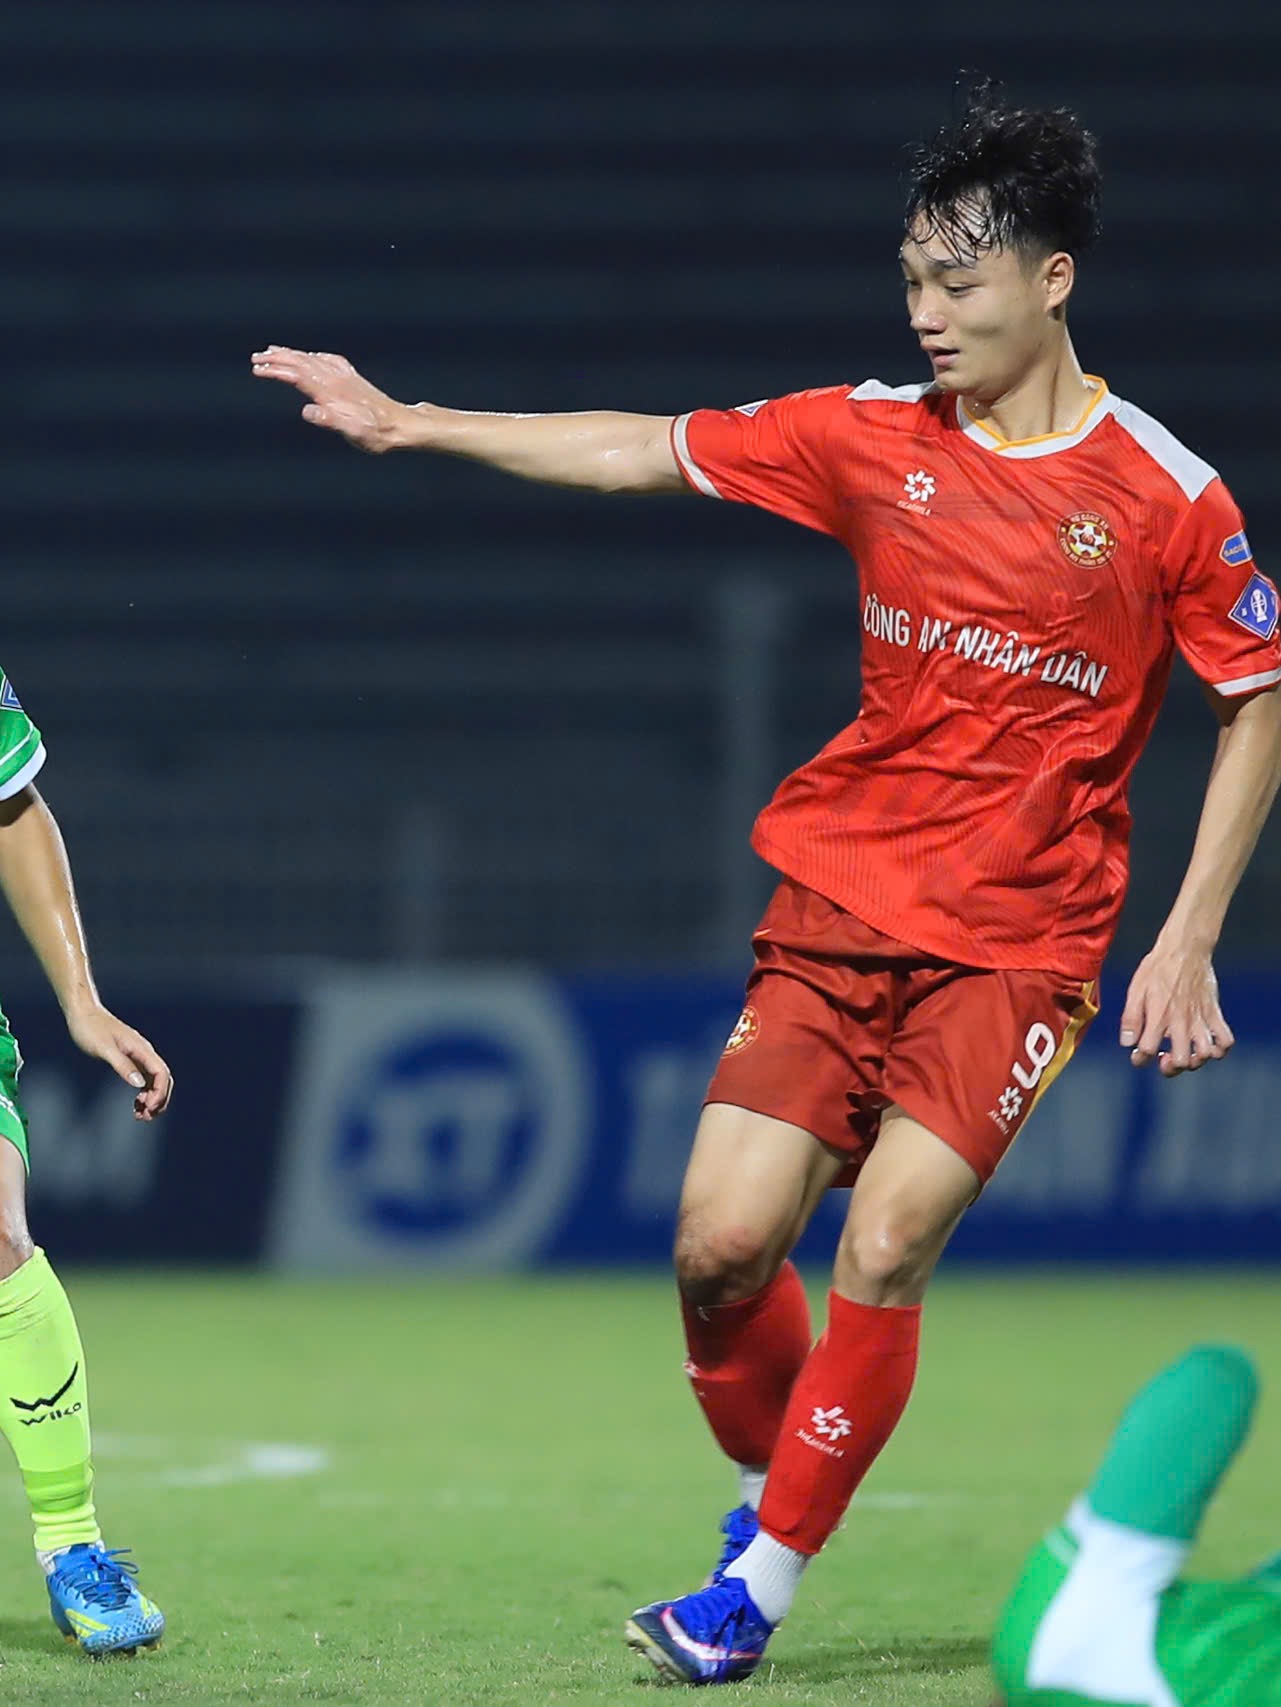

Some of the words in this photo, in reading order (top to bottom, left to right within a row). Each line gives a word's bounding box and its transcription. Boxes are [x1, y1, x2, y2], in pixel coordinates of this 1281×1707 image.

[918, 616, 952, 653] AN
[953, 625, 1041, 677] NHÂN
[1040, 651, 1109, 697] DÂN
